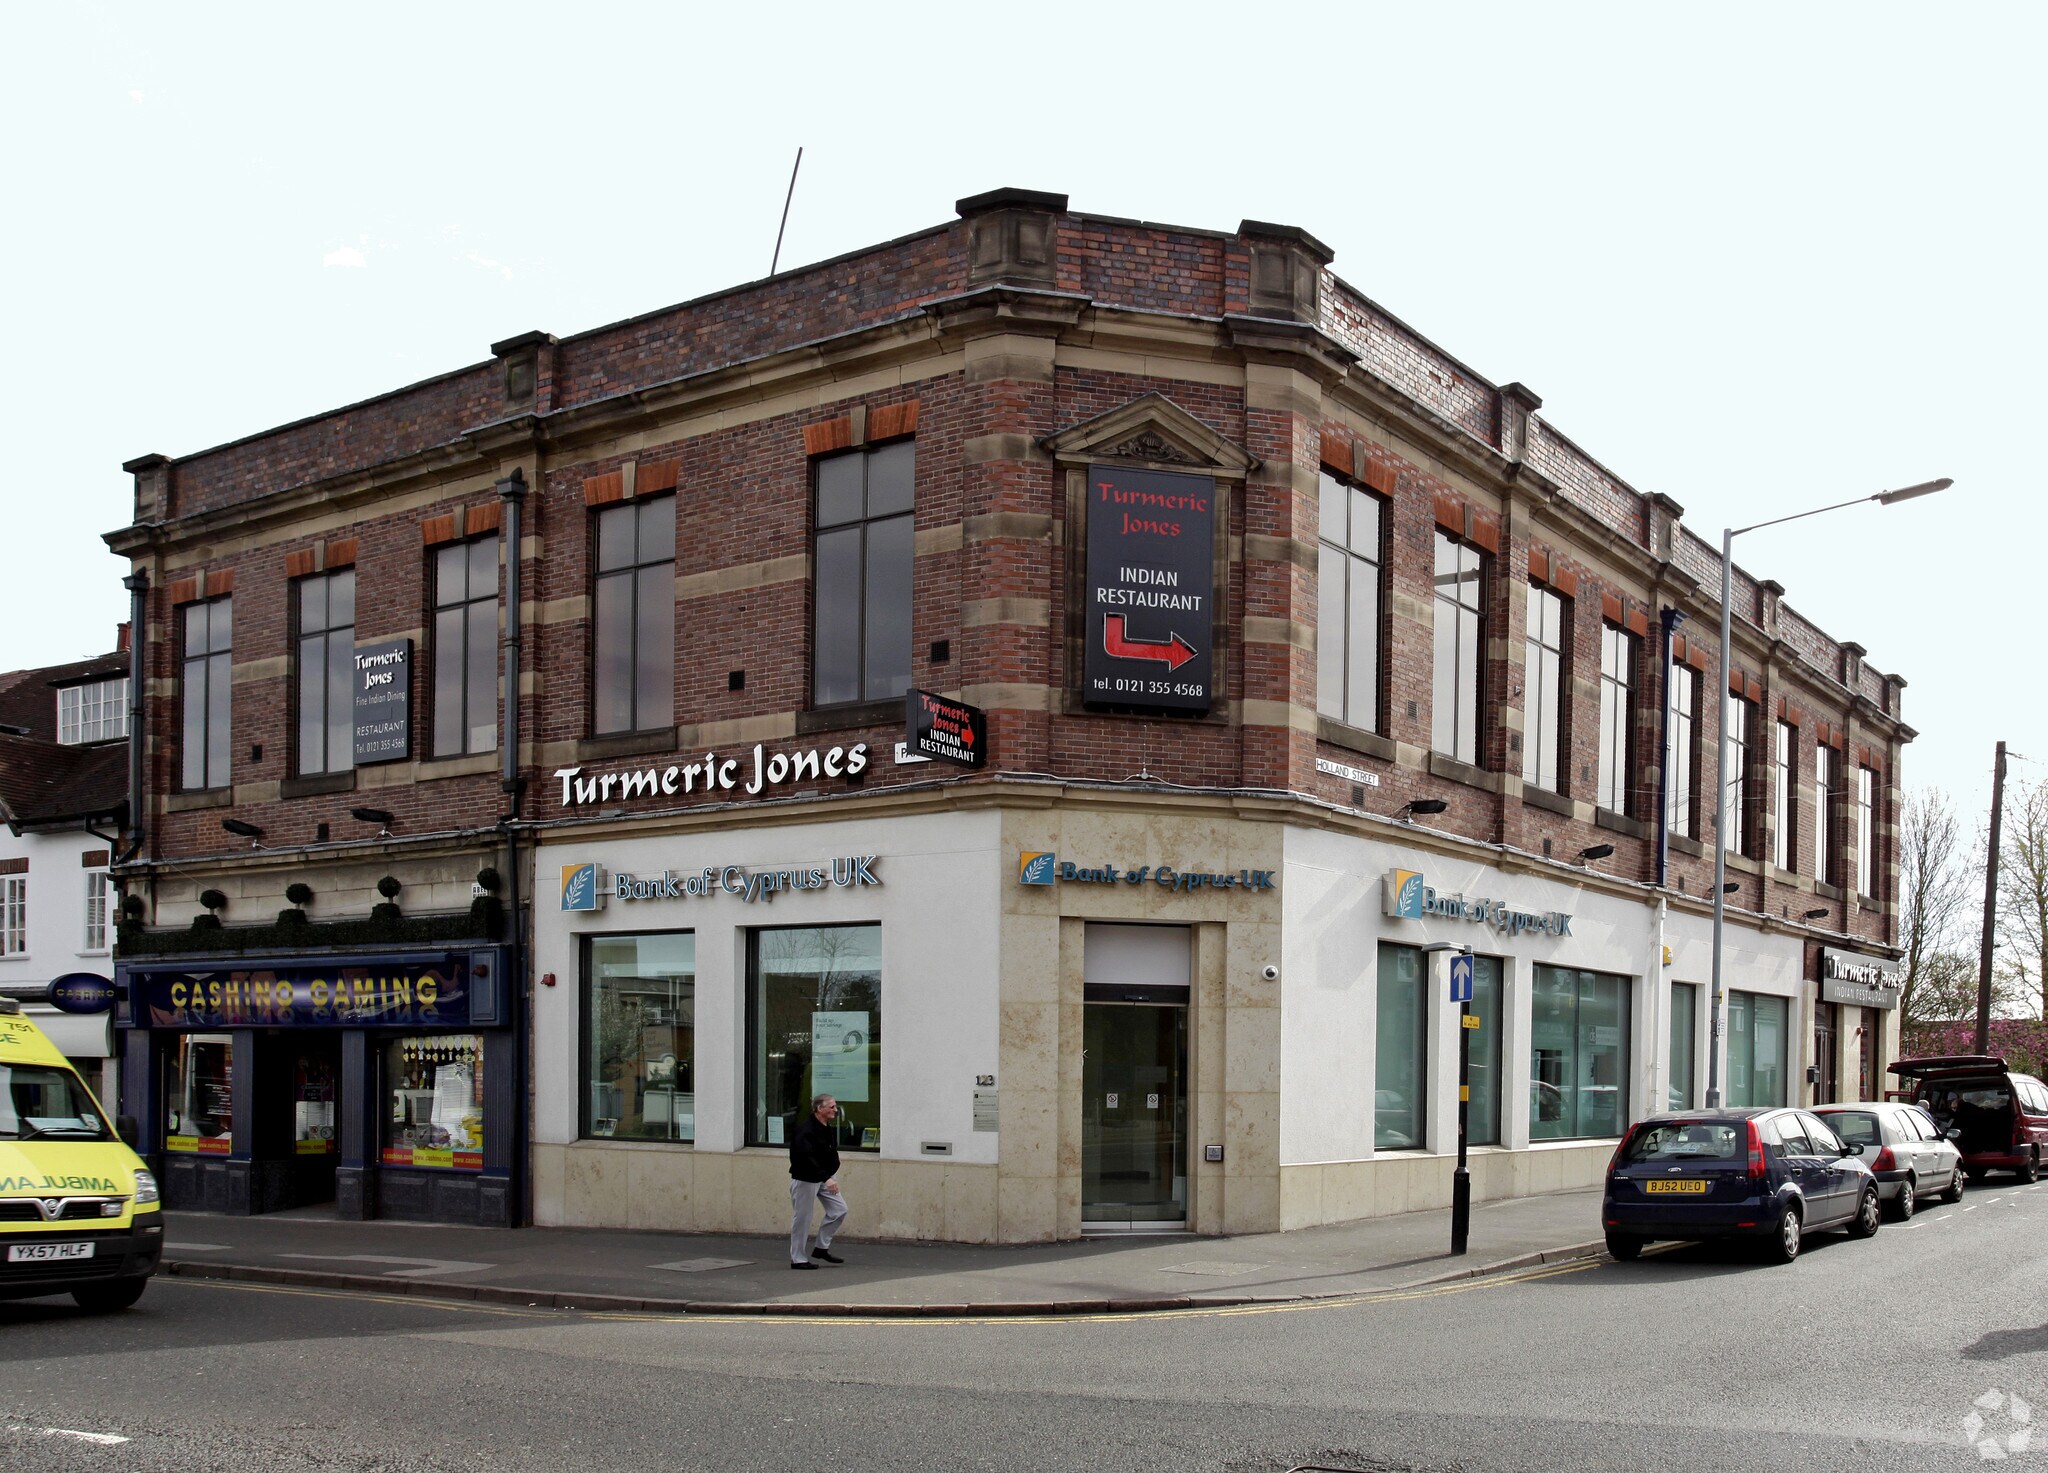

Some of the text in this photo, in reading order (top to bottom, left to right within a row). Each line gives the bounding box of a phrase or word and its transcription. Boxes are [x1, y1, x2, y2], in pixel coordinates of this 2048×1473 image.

[1097, 482, 1207, 512] Turmeric
[1120, 512, 1182, 537] Jones
[1120, 566, 1178, 587] INDIAN
[1097, 587, 1202, 612] RESTAURANT
[354, 649, 404, 669] Turmeric
[364, 672, 393, 689] Jones
[1094, 678, 1203, 697] tel. 0121 355 4568
[356, 691, 406, 706] Fine Indian Dining
[921, 695, 970, 723] Turmeric
[356, 720, 405, 737] RESTAURANT
[932, 713, 959, 734] Jones
[367, 741, 379, 752] 0121
[381, 740, 391, 750] 355
[930, 728, 960, 747] INDIAN
[920, 738, 974, 762] RESTAURANT
[553, 743, 868, 807] Turmeric Jones
[1316, 759, 1377, 784] HOLLAND STREET
[613, 854, 879, 902] Bank of Cyprus UK
[1060, 862, 1276, 892] Bank of Cyprus UK
[1424, 886, 1573, 938] Bank of Cyprus UK
[1832, 955, 1877, 985] Turmeric
[56, 988, 115, 998] CASHINO
[171, 975, 438, 1008] CASHINO GAMING
[976, 1074, 995, 1086] 123
[1651, 1181, 1701, 1191] BJ52 UEO
[17, 1244, 88, 1258] YX57 HLF
